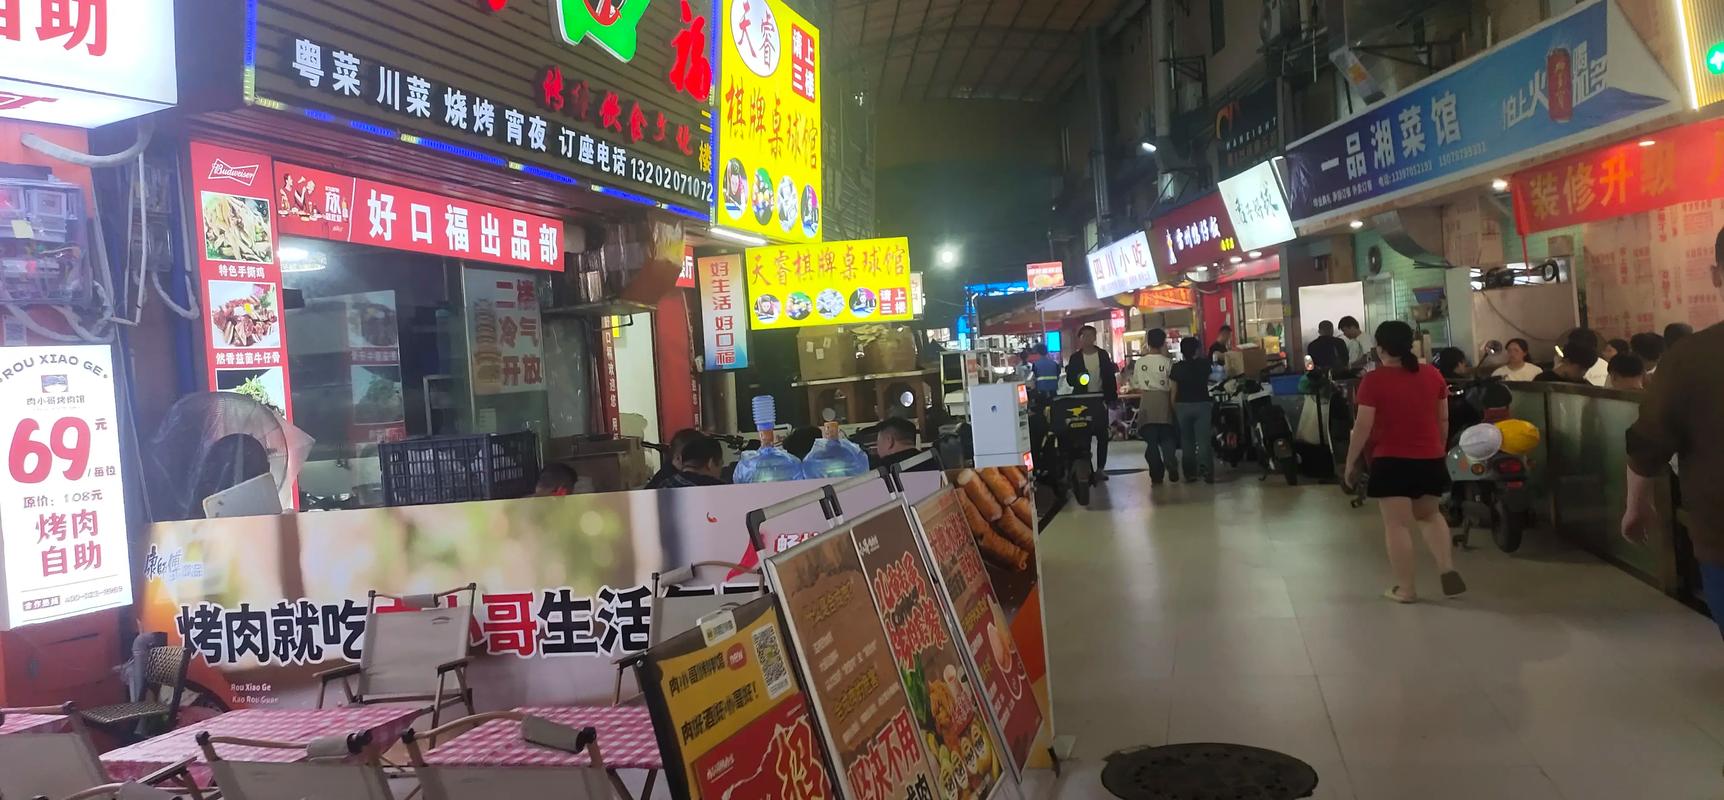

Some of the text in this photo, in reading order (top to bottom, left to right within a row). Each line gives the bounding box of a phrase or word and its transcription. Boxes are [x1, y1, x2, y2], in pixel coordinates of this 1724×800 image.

[0, 0, 108, 57] 助
[737, 0, 777, 68] 天睿
[292, 38, 714, 202] 粤菜 川菜 烧烤 宵夜 订座电话 13202071072
[726, 76, 818, 170] 棋牌桌球馆
[1321, 90, 1462, 180] 一品湘菜馆
[212, 163, 255, 179] Budweiser
[1529, 141, 1676, 221] 装修升级
[367, 189, 559, 265] 好口福出品部
[218, 264, 265, 279] 特色手撕鸡
[752, 244, 905, 286] 天睿棋牌桌球馆
[1093, 239, 1148, 281] 四川小吃
[2, 354, 103, 379] ROU XIAO GE
[8, 416, 107, 484] 69 元
[36, 508, 99, 544] 烤肉
[41, 541, 102, 577] 自助
[231, 683, 271, 691] Rou Xiao Ge
